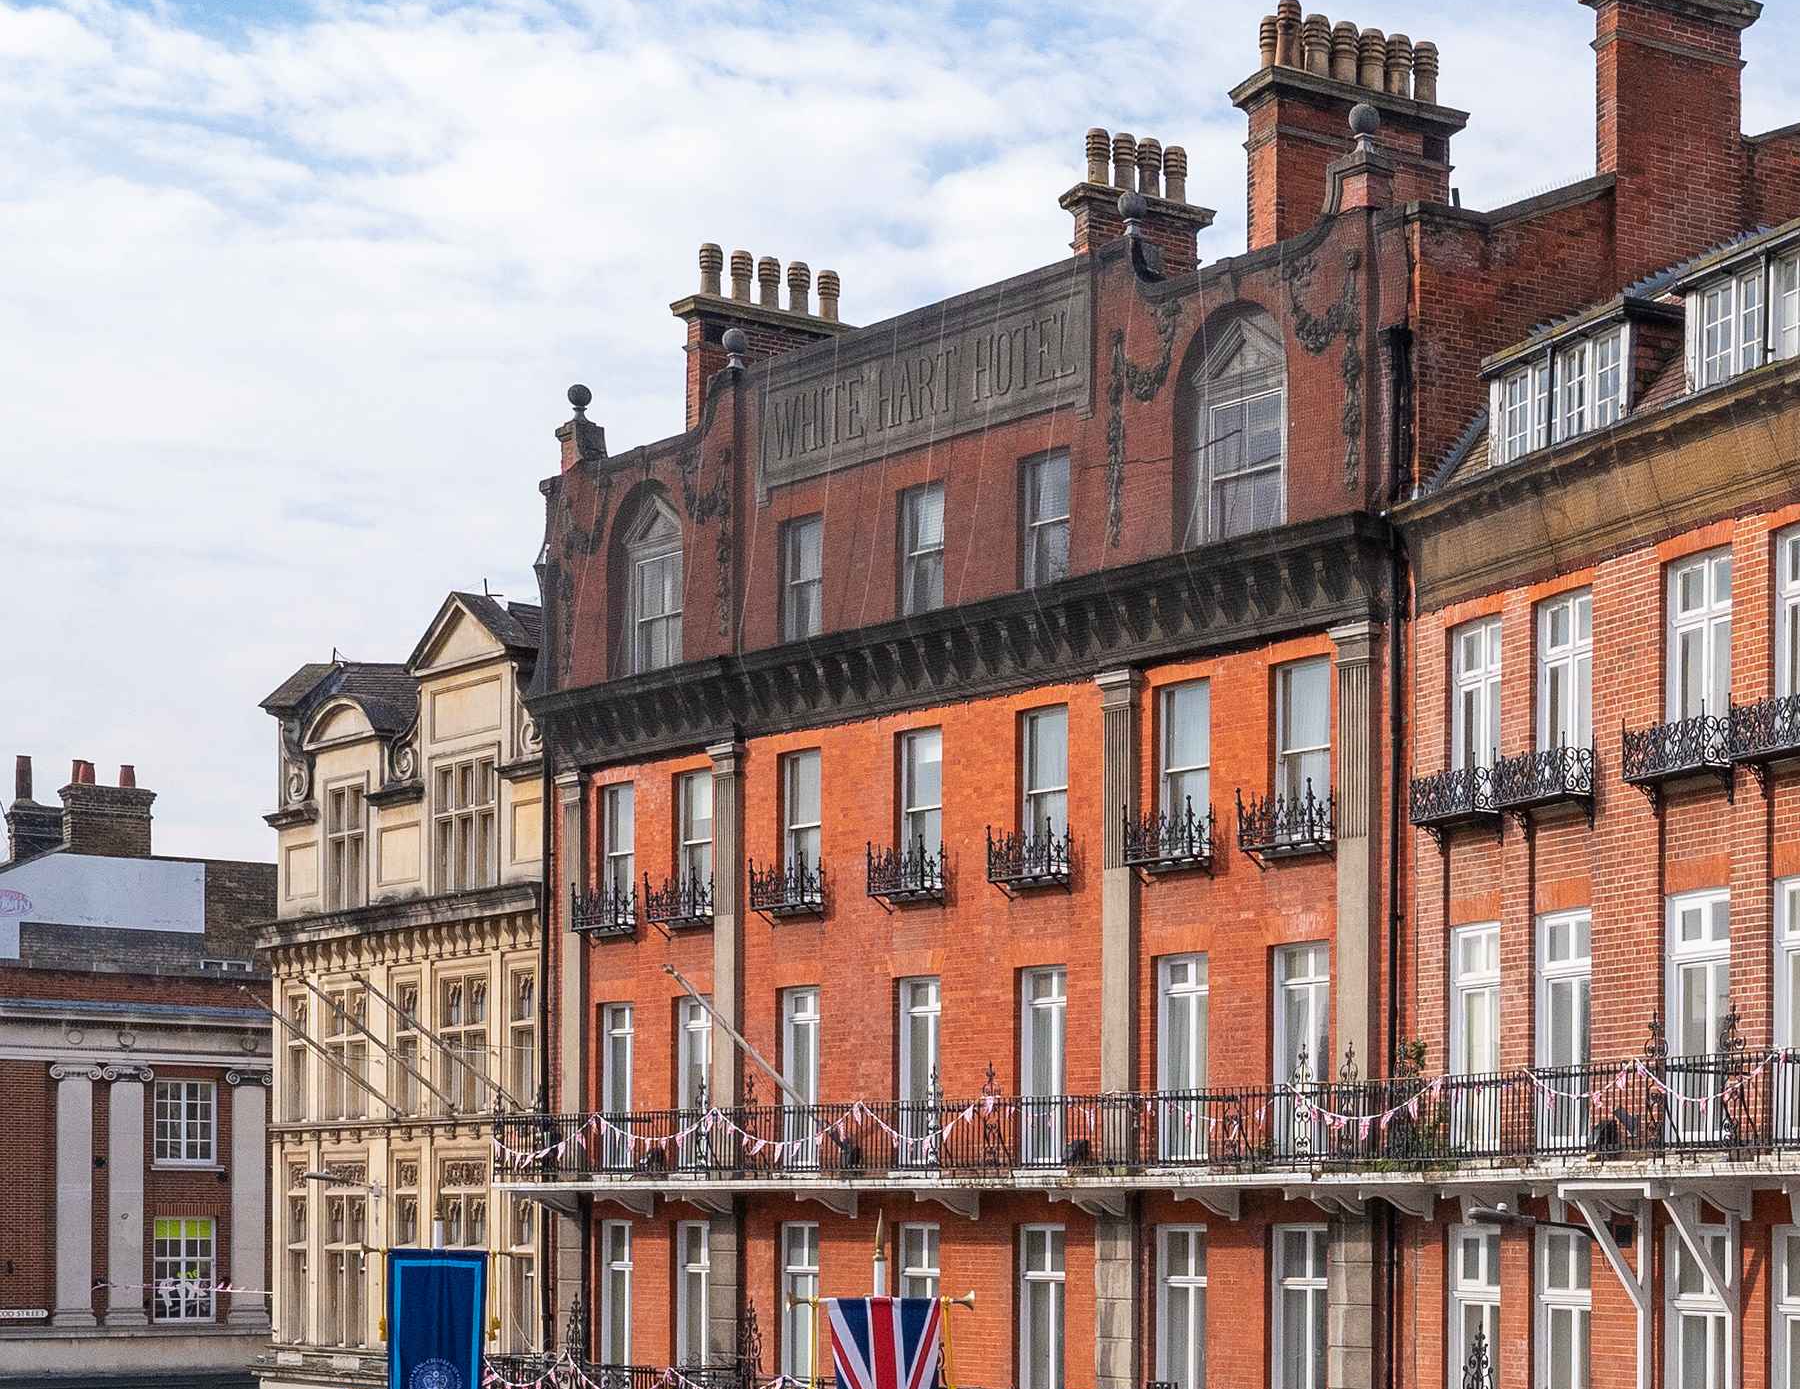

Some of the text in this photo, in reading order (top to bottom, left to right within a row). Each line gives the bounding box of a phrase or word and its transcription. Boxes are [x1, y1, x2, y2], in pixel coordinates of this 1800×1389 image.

[774, 309, 1077, 461] WHITE HART HOTEL
